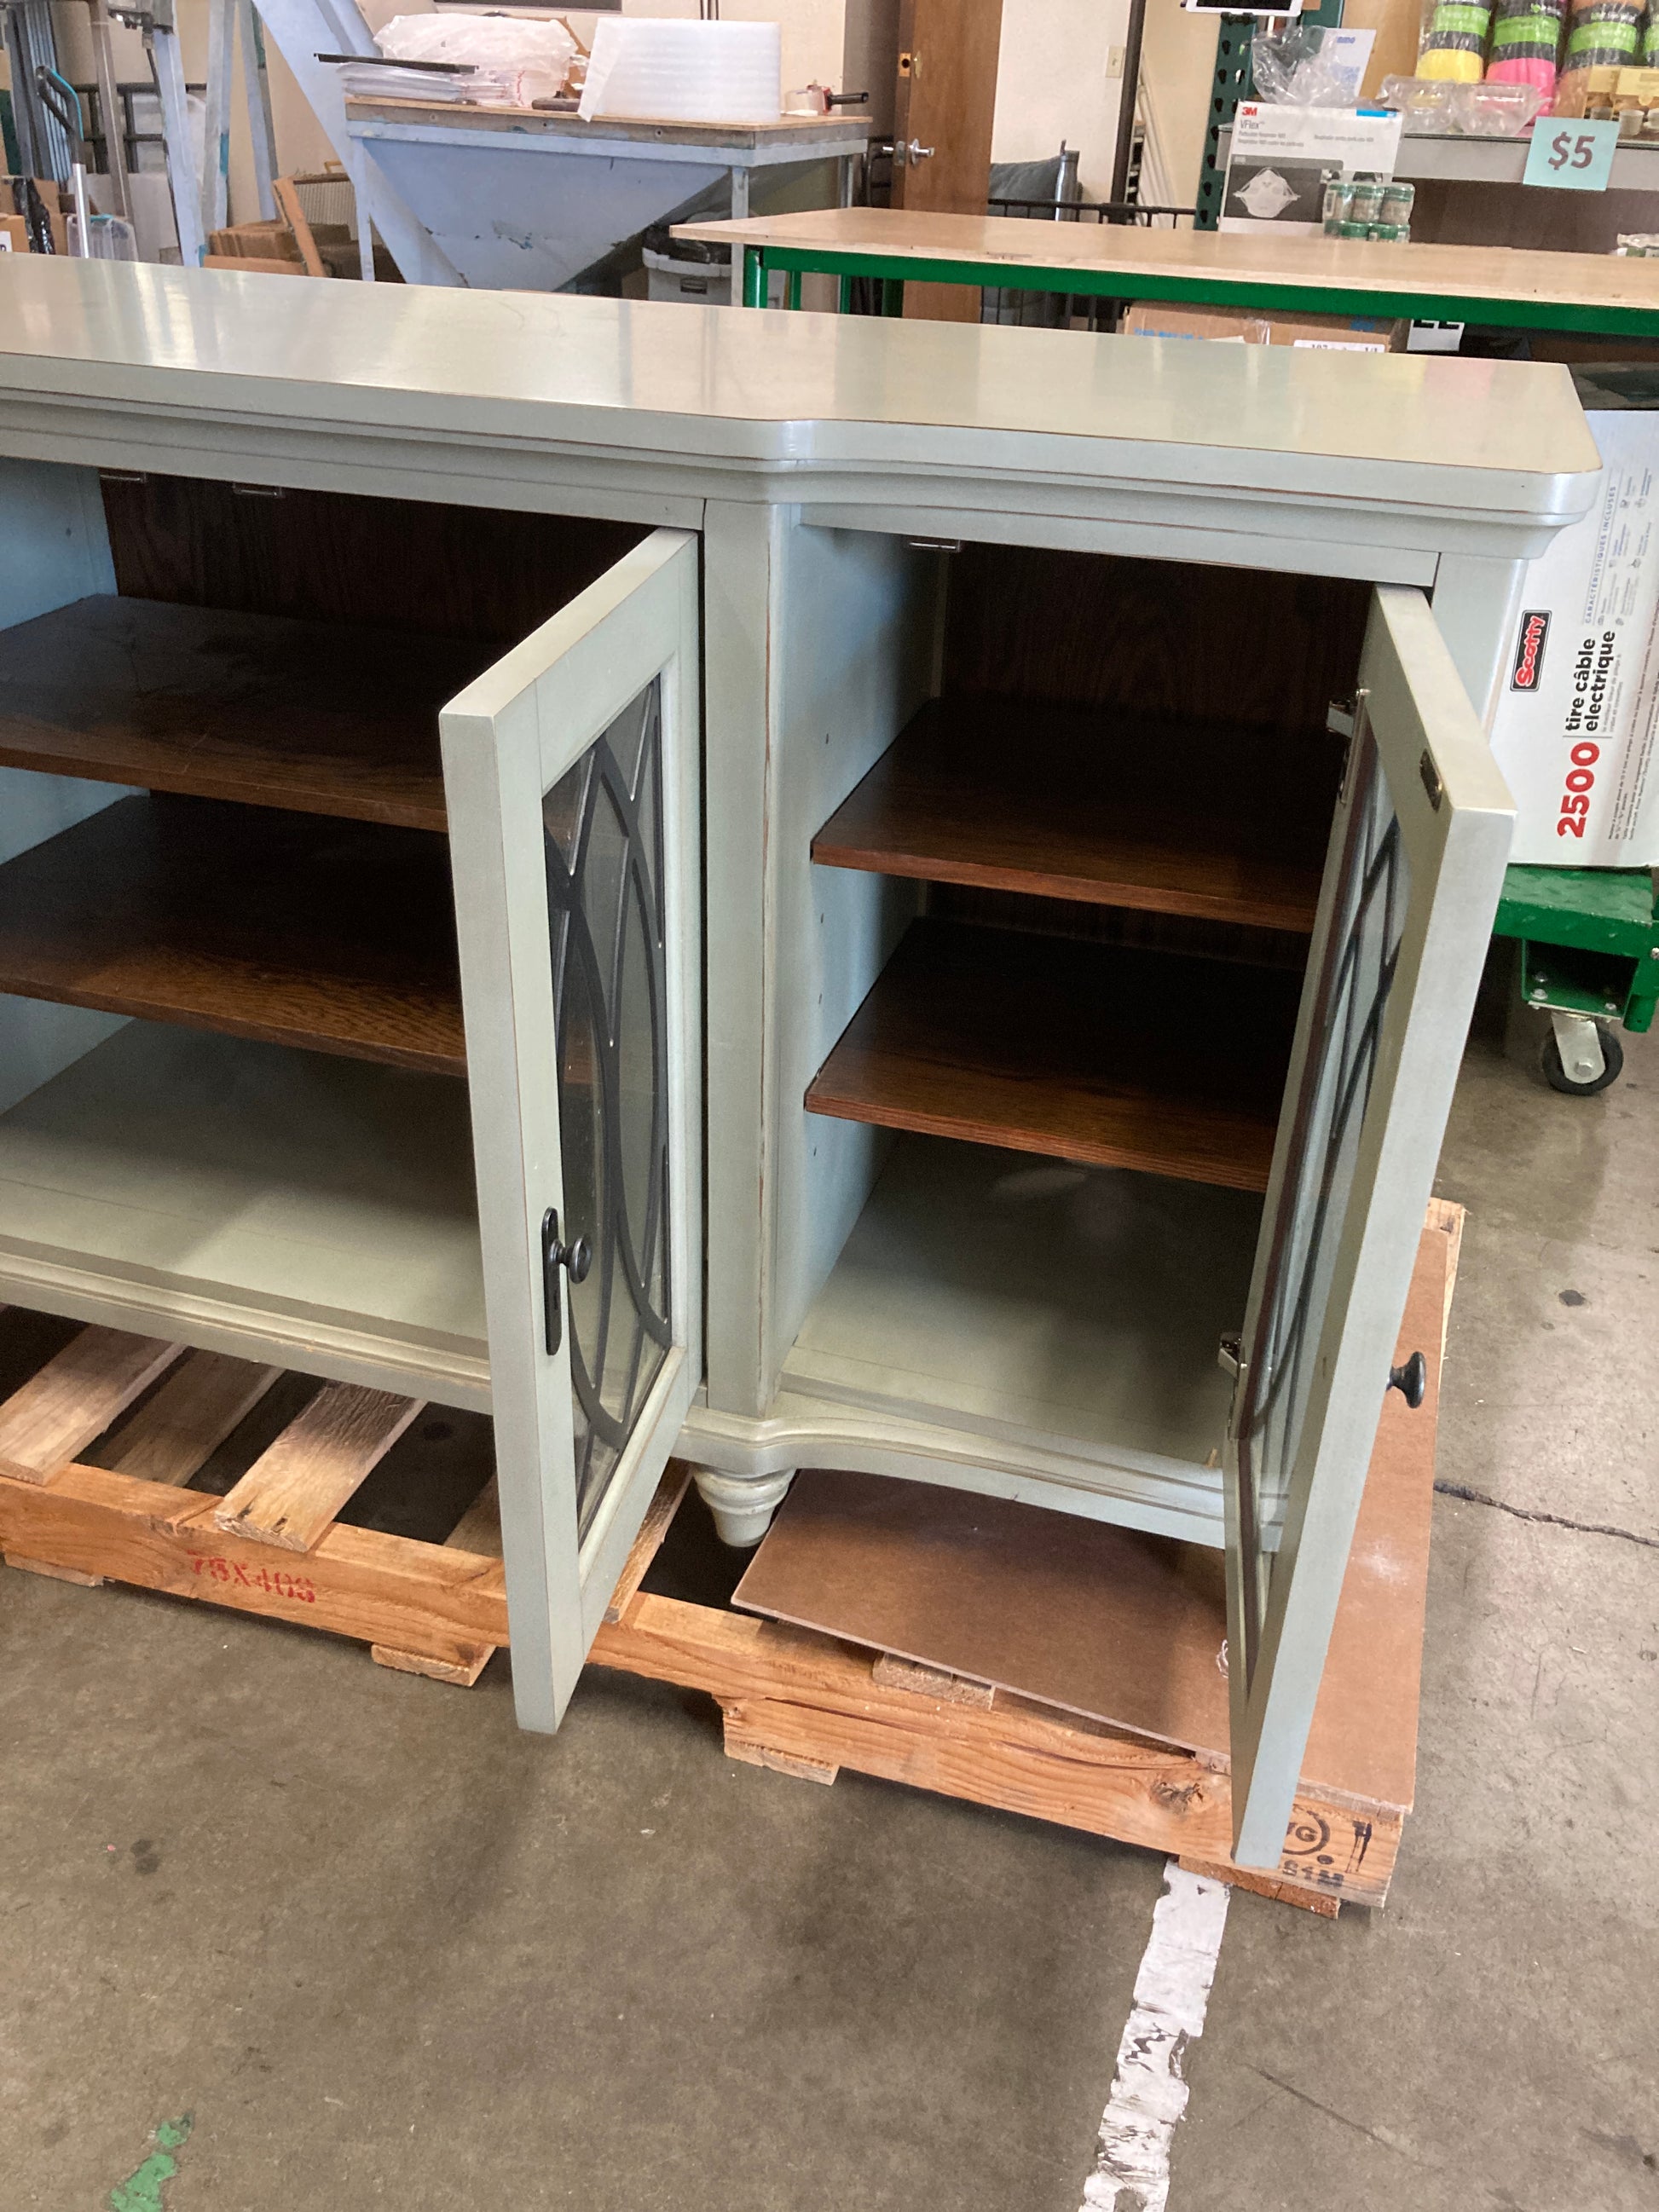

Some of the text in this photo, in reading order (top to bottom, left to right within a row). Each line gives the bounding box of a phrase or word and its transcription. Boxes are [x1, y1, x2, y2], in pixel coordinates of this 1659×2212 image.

[1241, 107, 1257, 116] 3M
[1547, 131, 1596, 170] $5
[1603, 486, 1616, 532] INCLUSES
[1515, 615, 1546, 687] Scotty
[1565, 638, 1595, 731] tire câble
[1584, 631, 1616, 731] electrique
[1557, 742, 1600, 838] 2500
